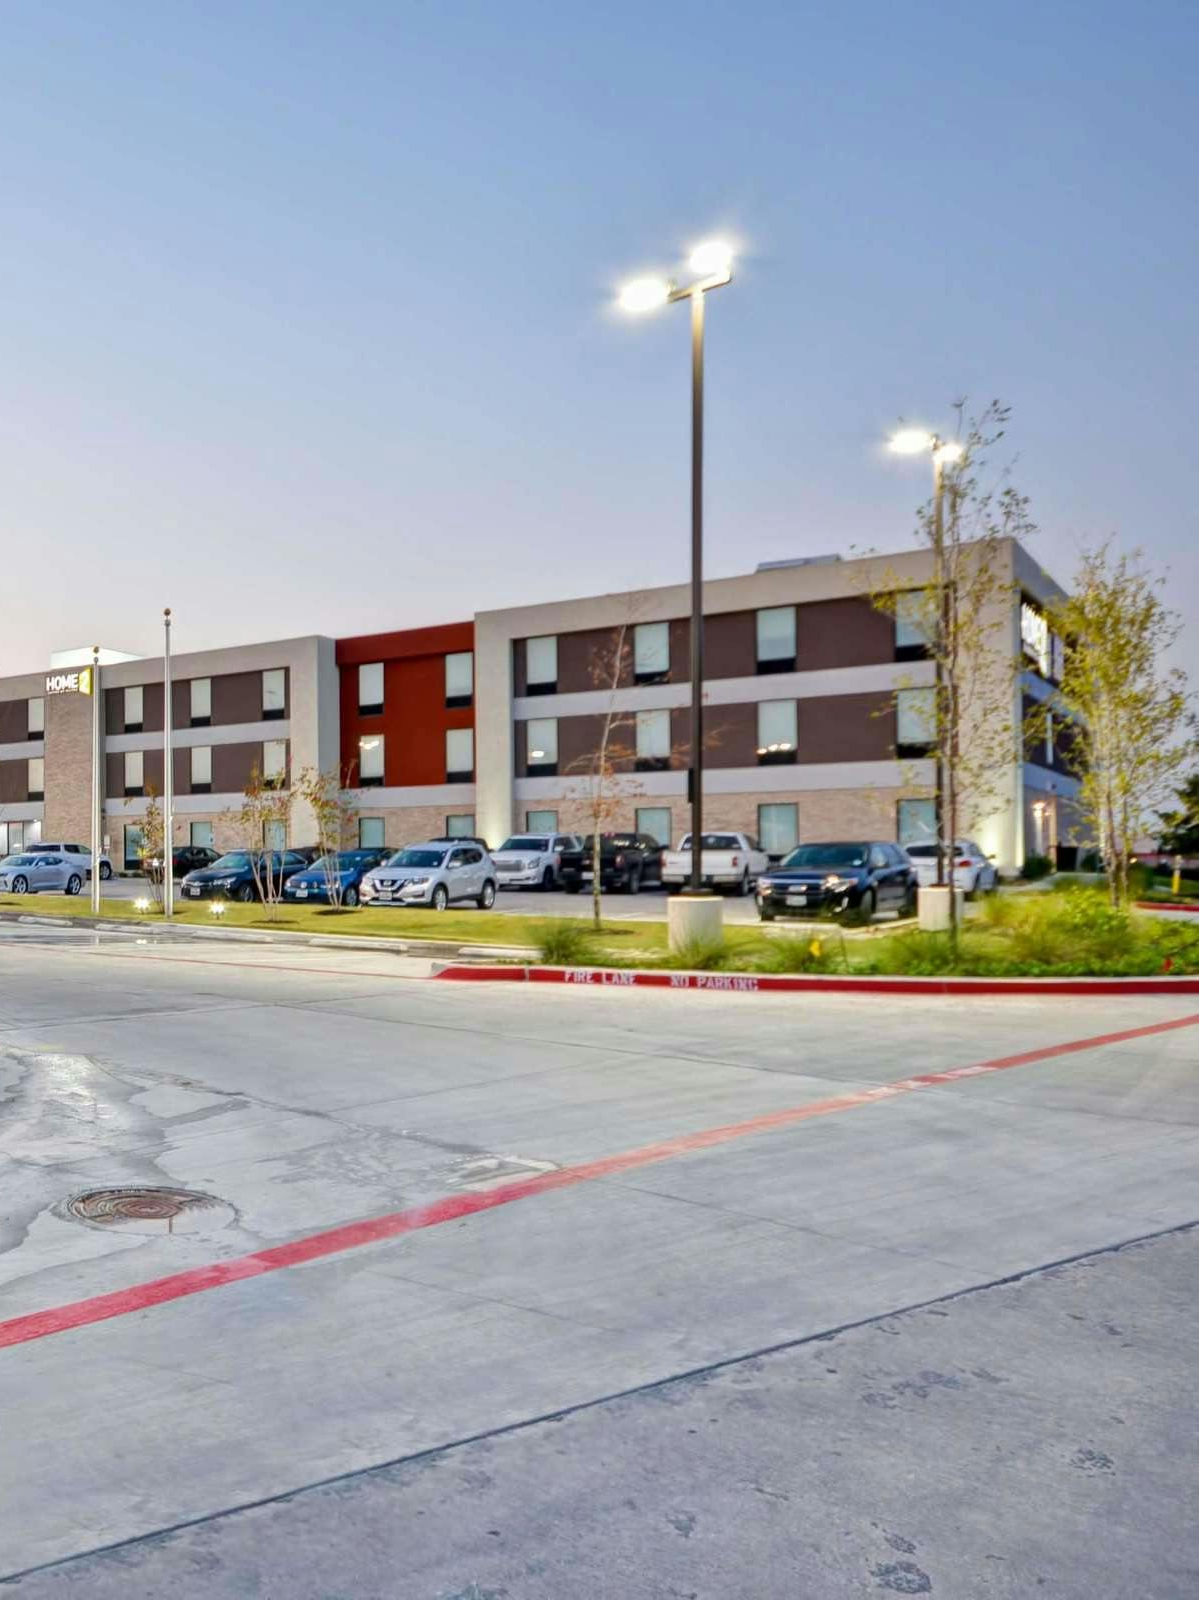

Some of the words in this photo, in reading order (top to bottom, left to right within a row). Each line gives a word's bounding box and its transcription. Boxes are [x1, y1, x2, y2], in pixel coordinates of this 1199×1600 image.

[46, 673, 79, 691] HOME
[564, 970, 594, 983] FIRE
[602, 971, 637, 985] LANE
[670, 975, 690, 988] NO
[697, 976, 759, 991] PARKING
